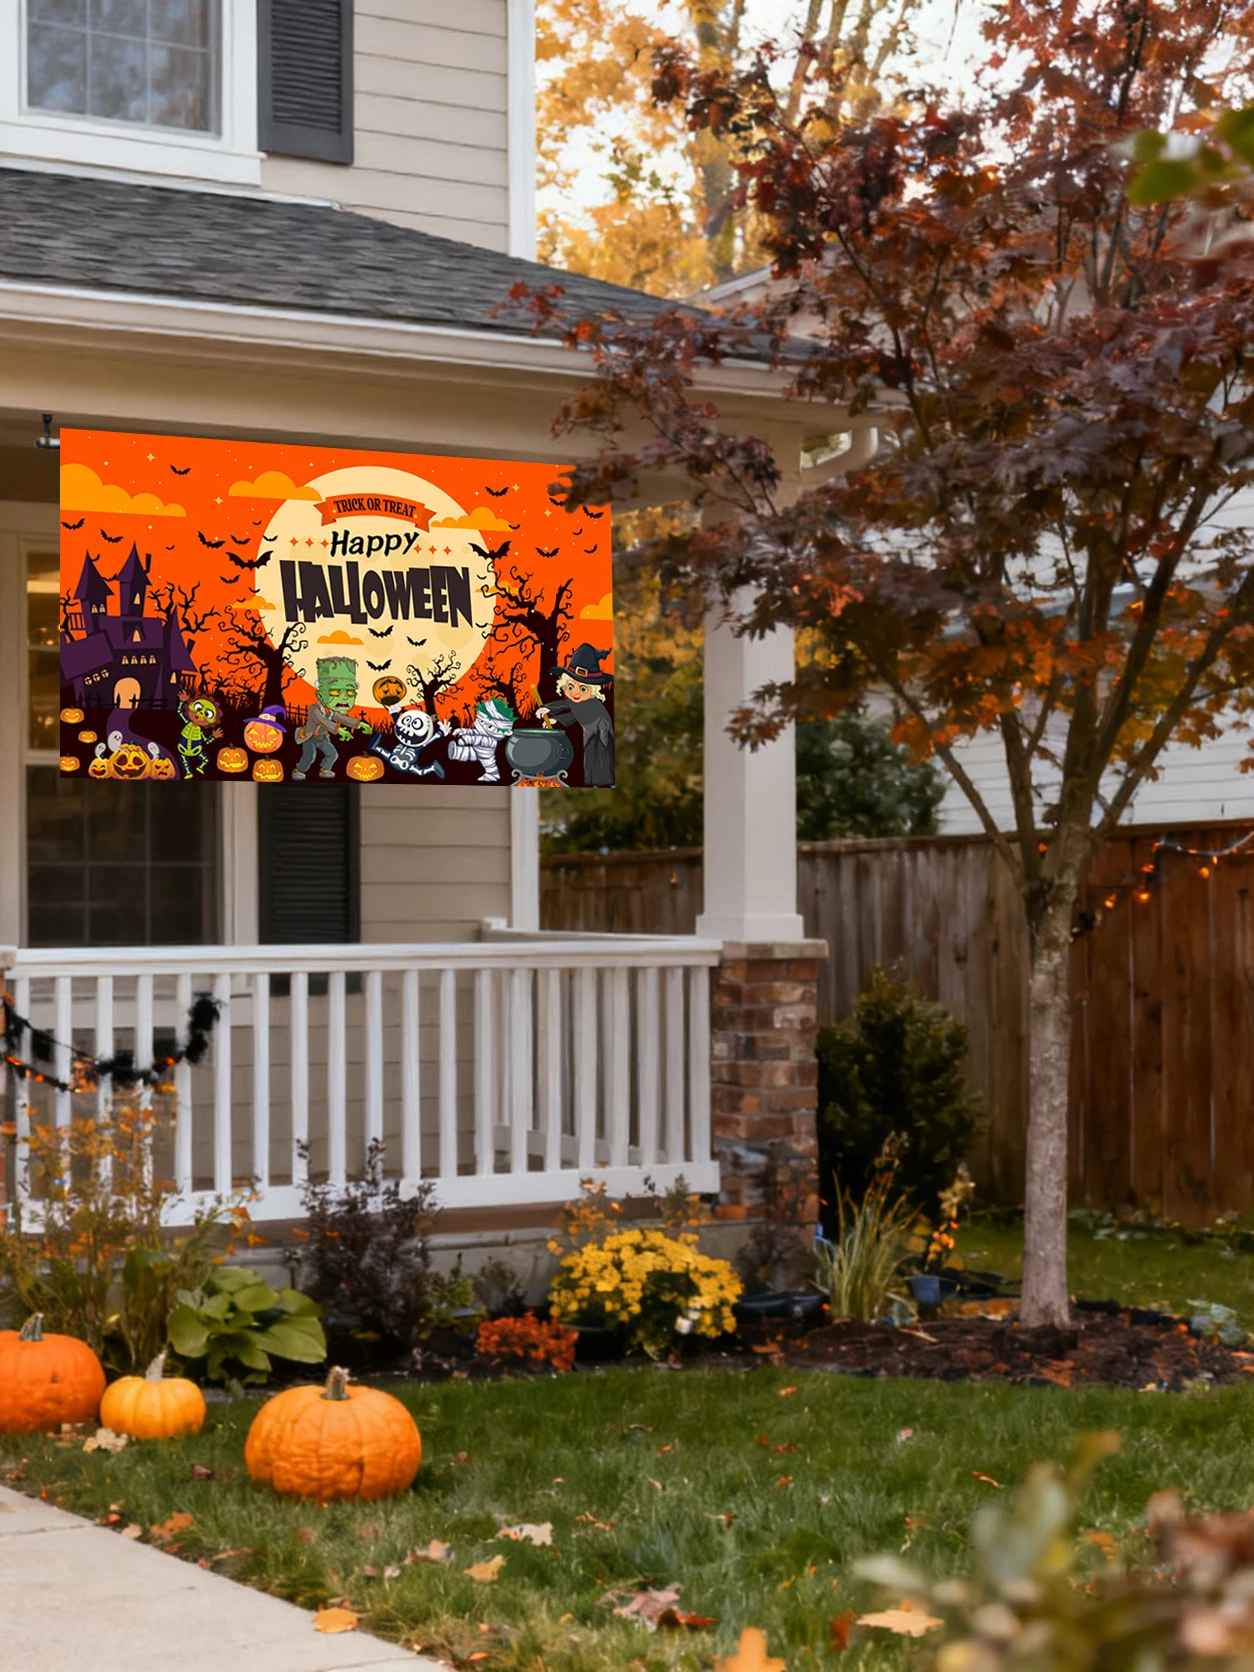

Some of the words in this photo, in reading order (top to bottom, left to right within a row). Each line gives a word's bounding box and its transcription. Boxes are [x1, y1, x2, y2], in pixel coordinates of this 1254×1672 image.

[333, 497, 366, 514] TRICK
[367, 497, 381, 512] OR
[382, 499, 416, 518] TREAT
[331, 529, 420, 558] Happy
[279, 559, 473, 628] HALLOWEEN
